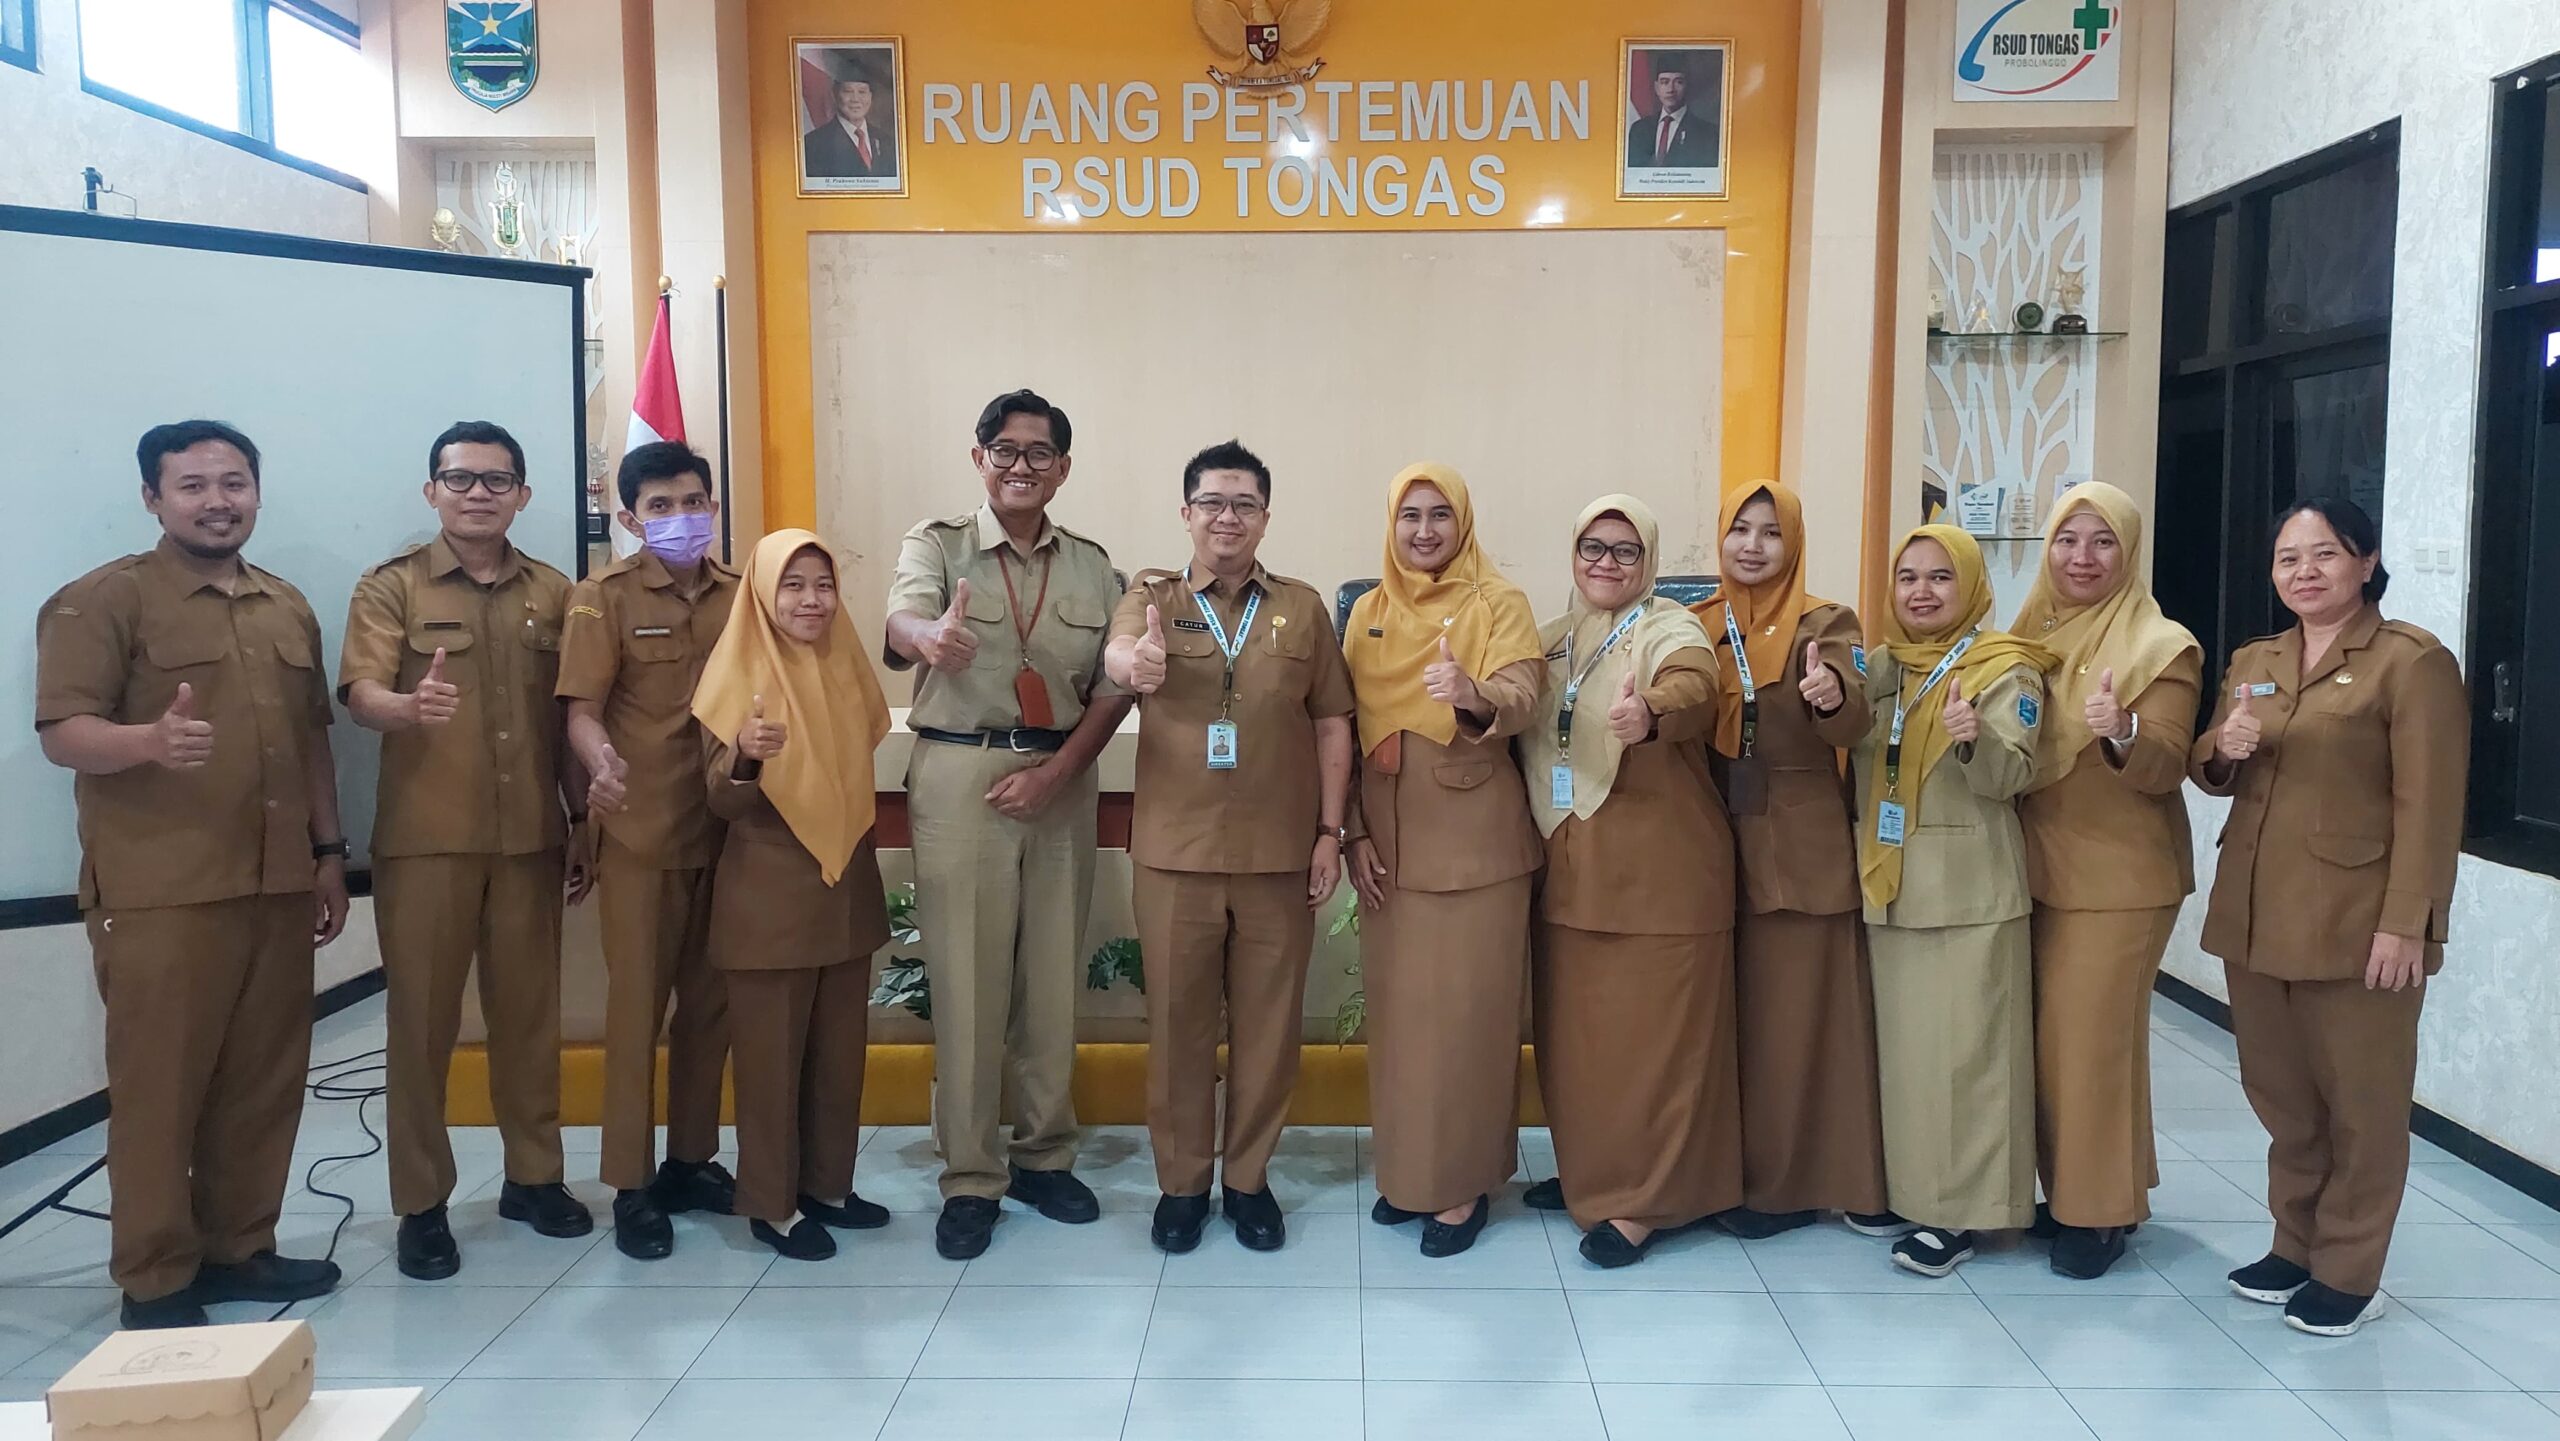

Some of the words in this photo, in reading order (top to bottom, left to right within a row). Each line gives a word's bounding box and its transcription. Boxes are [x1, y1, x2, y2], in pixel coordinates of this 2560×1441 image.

[1993, 34, 2027, 55] RSUD
[2030, 33, 2079, 55] TONGAS
[2004, 59, 2067, 67] PROBOLINGGO
[923, 82, 1161, 144] RUANG
[1181, 79, 1590, 143] PERTEMUAN
[1022, 157, 1200, 219] RSUD
[1223, 154, 1507, 218] TONGAS
[1198, 595, 1210, 613] TONGAS
[1180, 621, 1203, 629] CATUR
[1207, 613, 1216, 626] RSUD
[1238, 620, 1248, 638] TONGAS
[1730, 627, 1738, 643] TONGAS
[1928, 666, 1945, 685] TONGAS
